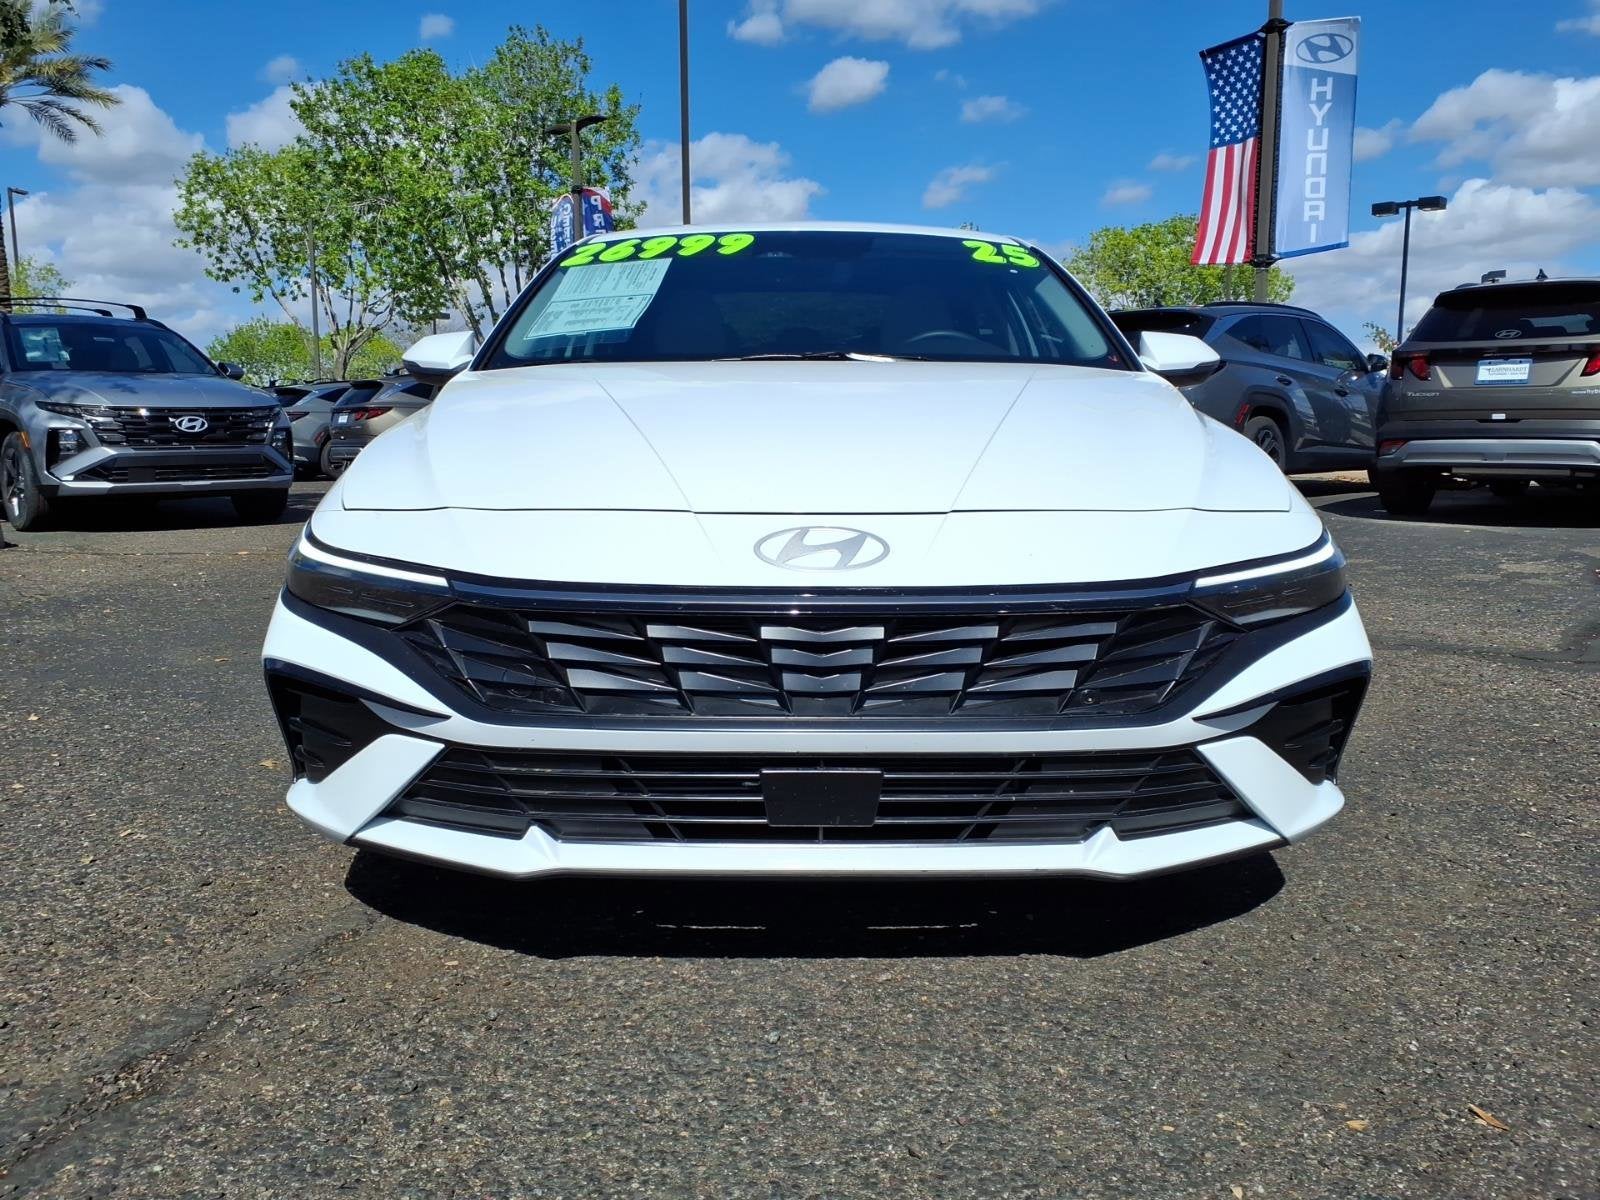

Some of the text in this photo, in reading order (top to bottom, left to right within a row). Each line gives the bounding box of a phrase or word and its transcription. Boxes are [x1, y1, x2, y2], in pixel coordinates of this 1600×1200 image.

[1303, 76, 1333, 244] HYUNDAI
[559, 232, 756, 268] 26999
[962, 240, 1041, 268] 25
